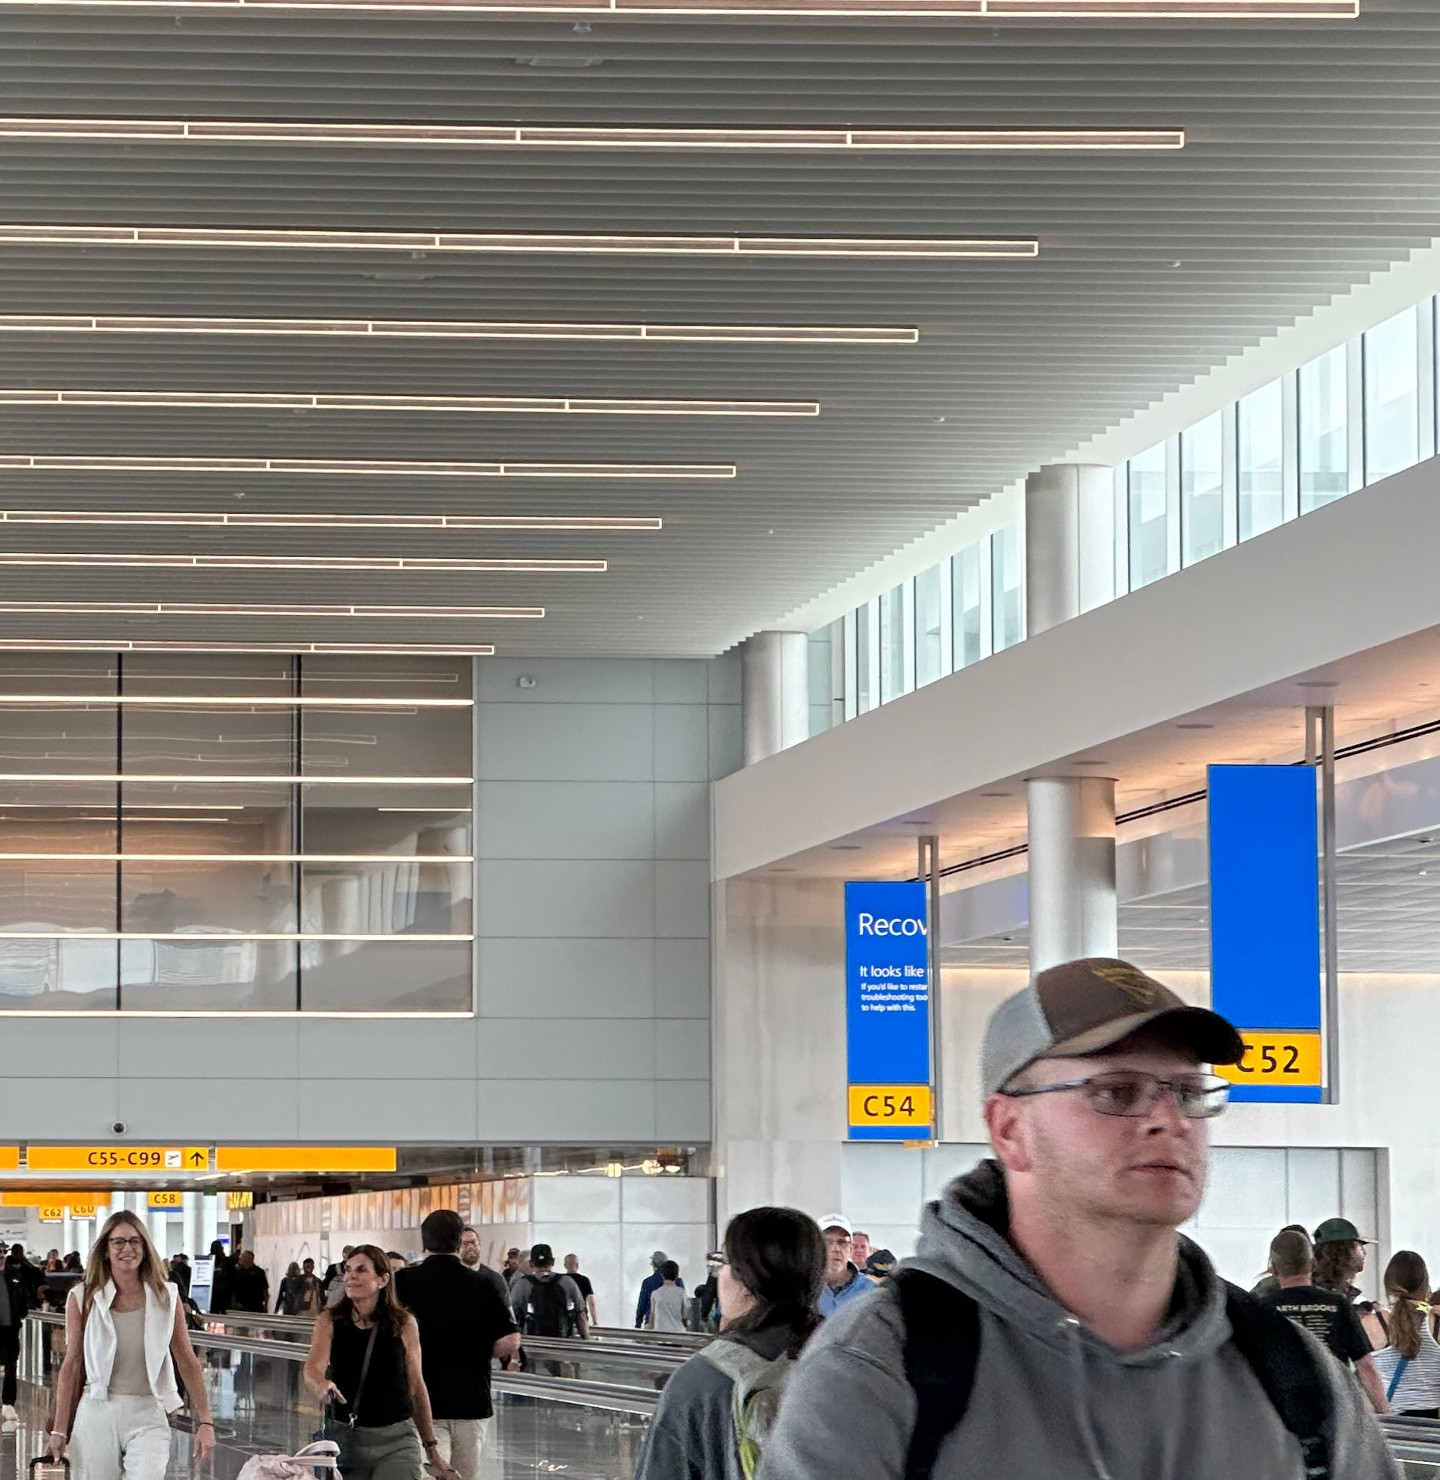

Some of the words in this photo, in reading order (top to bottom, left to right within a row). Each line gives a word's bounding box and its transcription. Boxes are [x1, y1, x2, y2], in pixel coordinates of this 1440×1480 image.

[858, 913, 928, 936] Recov
[860, 966, 868, 977] It
[871, 965, 902, 977] looks
[904, 965, 924, 978] like
[861, 993, 915, 1002] troubleshooting
[870, 1004, 885, 1012] help
[863, 1095, 915, 1117] C54
[88, 1152, 161, 1165] C55-C99
[154, 1193, 176, 1203] C58
[43, 1208, 61, 1217] C62
